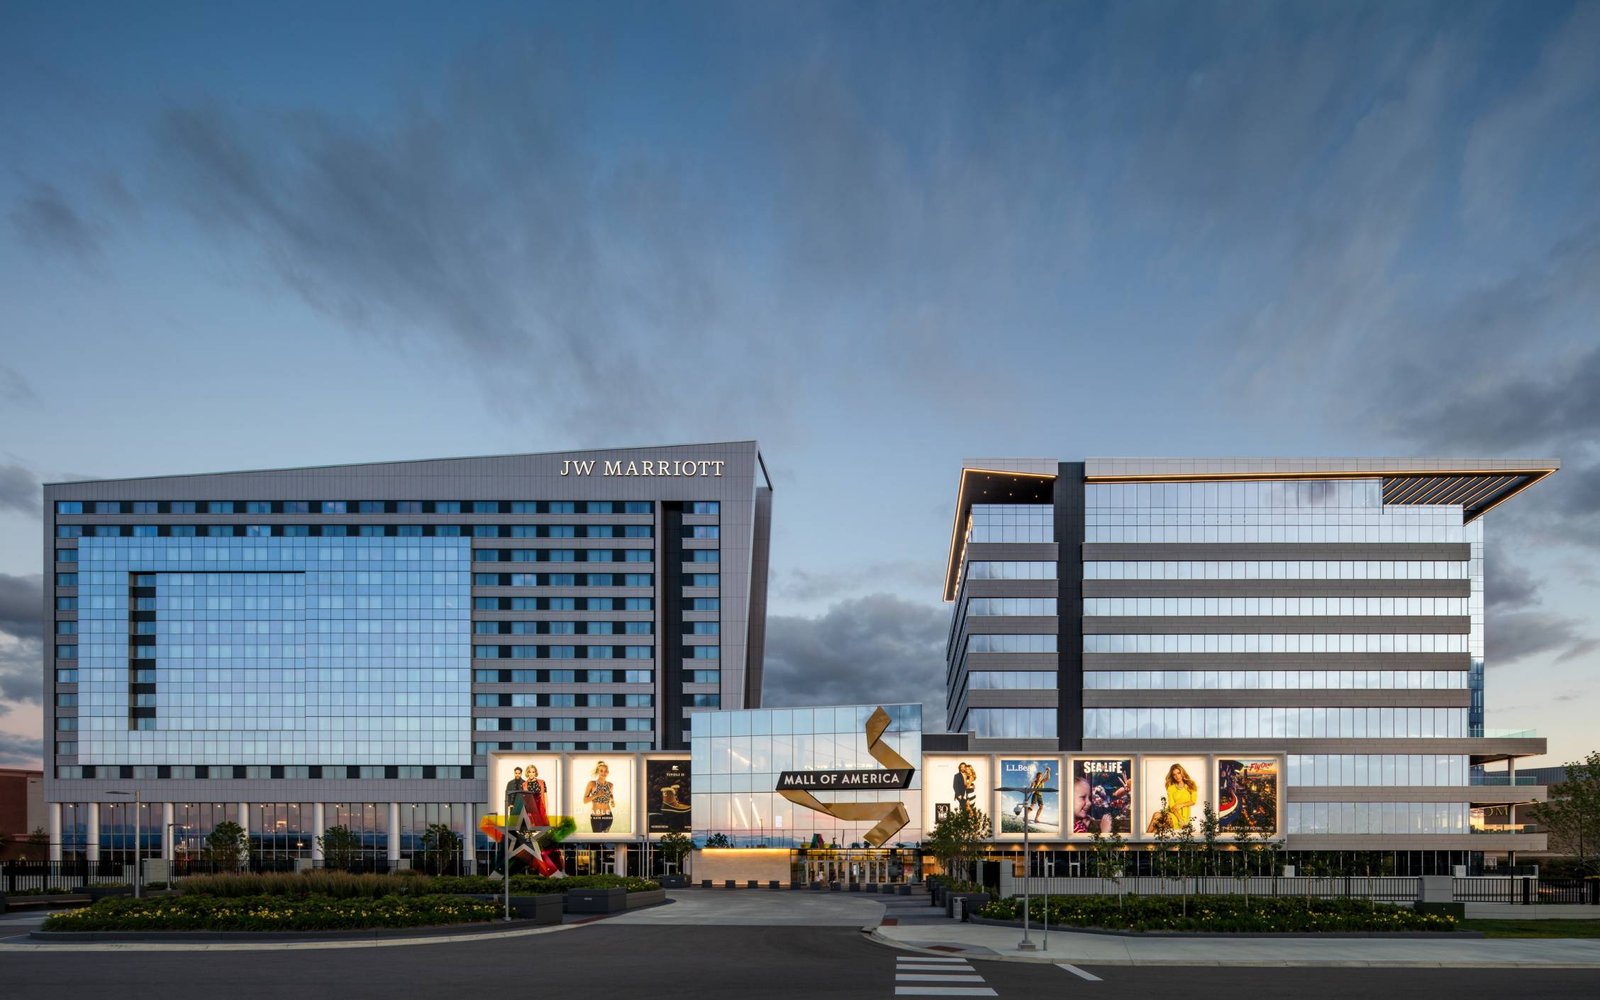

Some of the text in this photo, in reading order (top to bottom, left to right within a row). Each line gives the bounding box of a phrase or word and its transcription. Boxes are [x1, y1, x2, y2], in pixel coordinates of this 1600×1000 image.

[560, 460, 725, 477] JW MARRIOTT
[1083, 761, 1102, 774] SEA
[784, 772, 900, 785] MALL OF AMERICA
